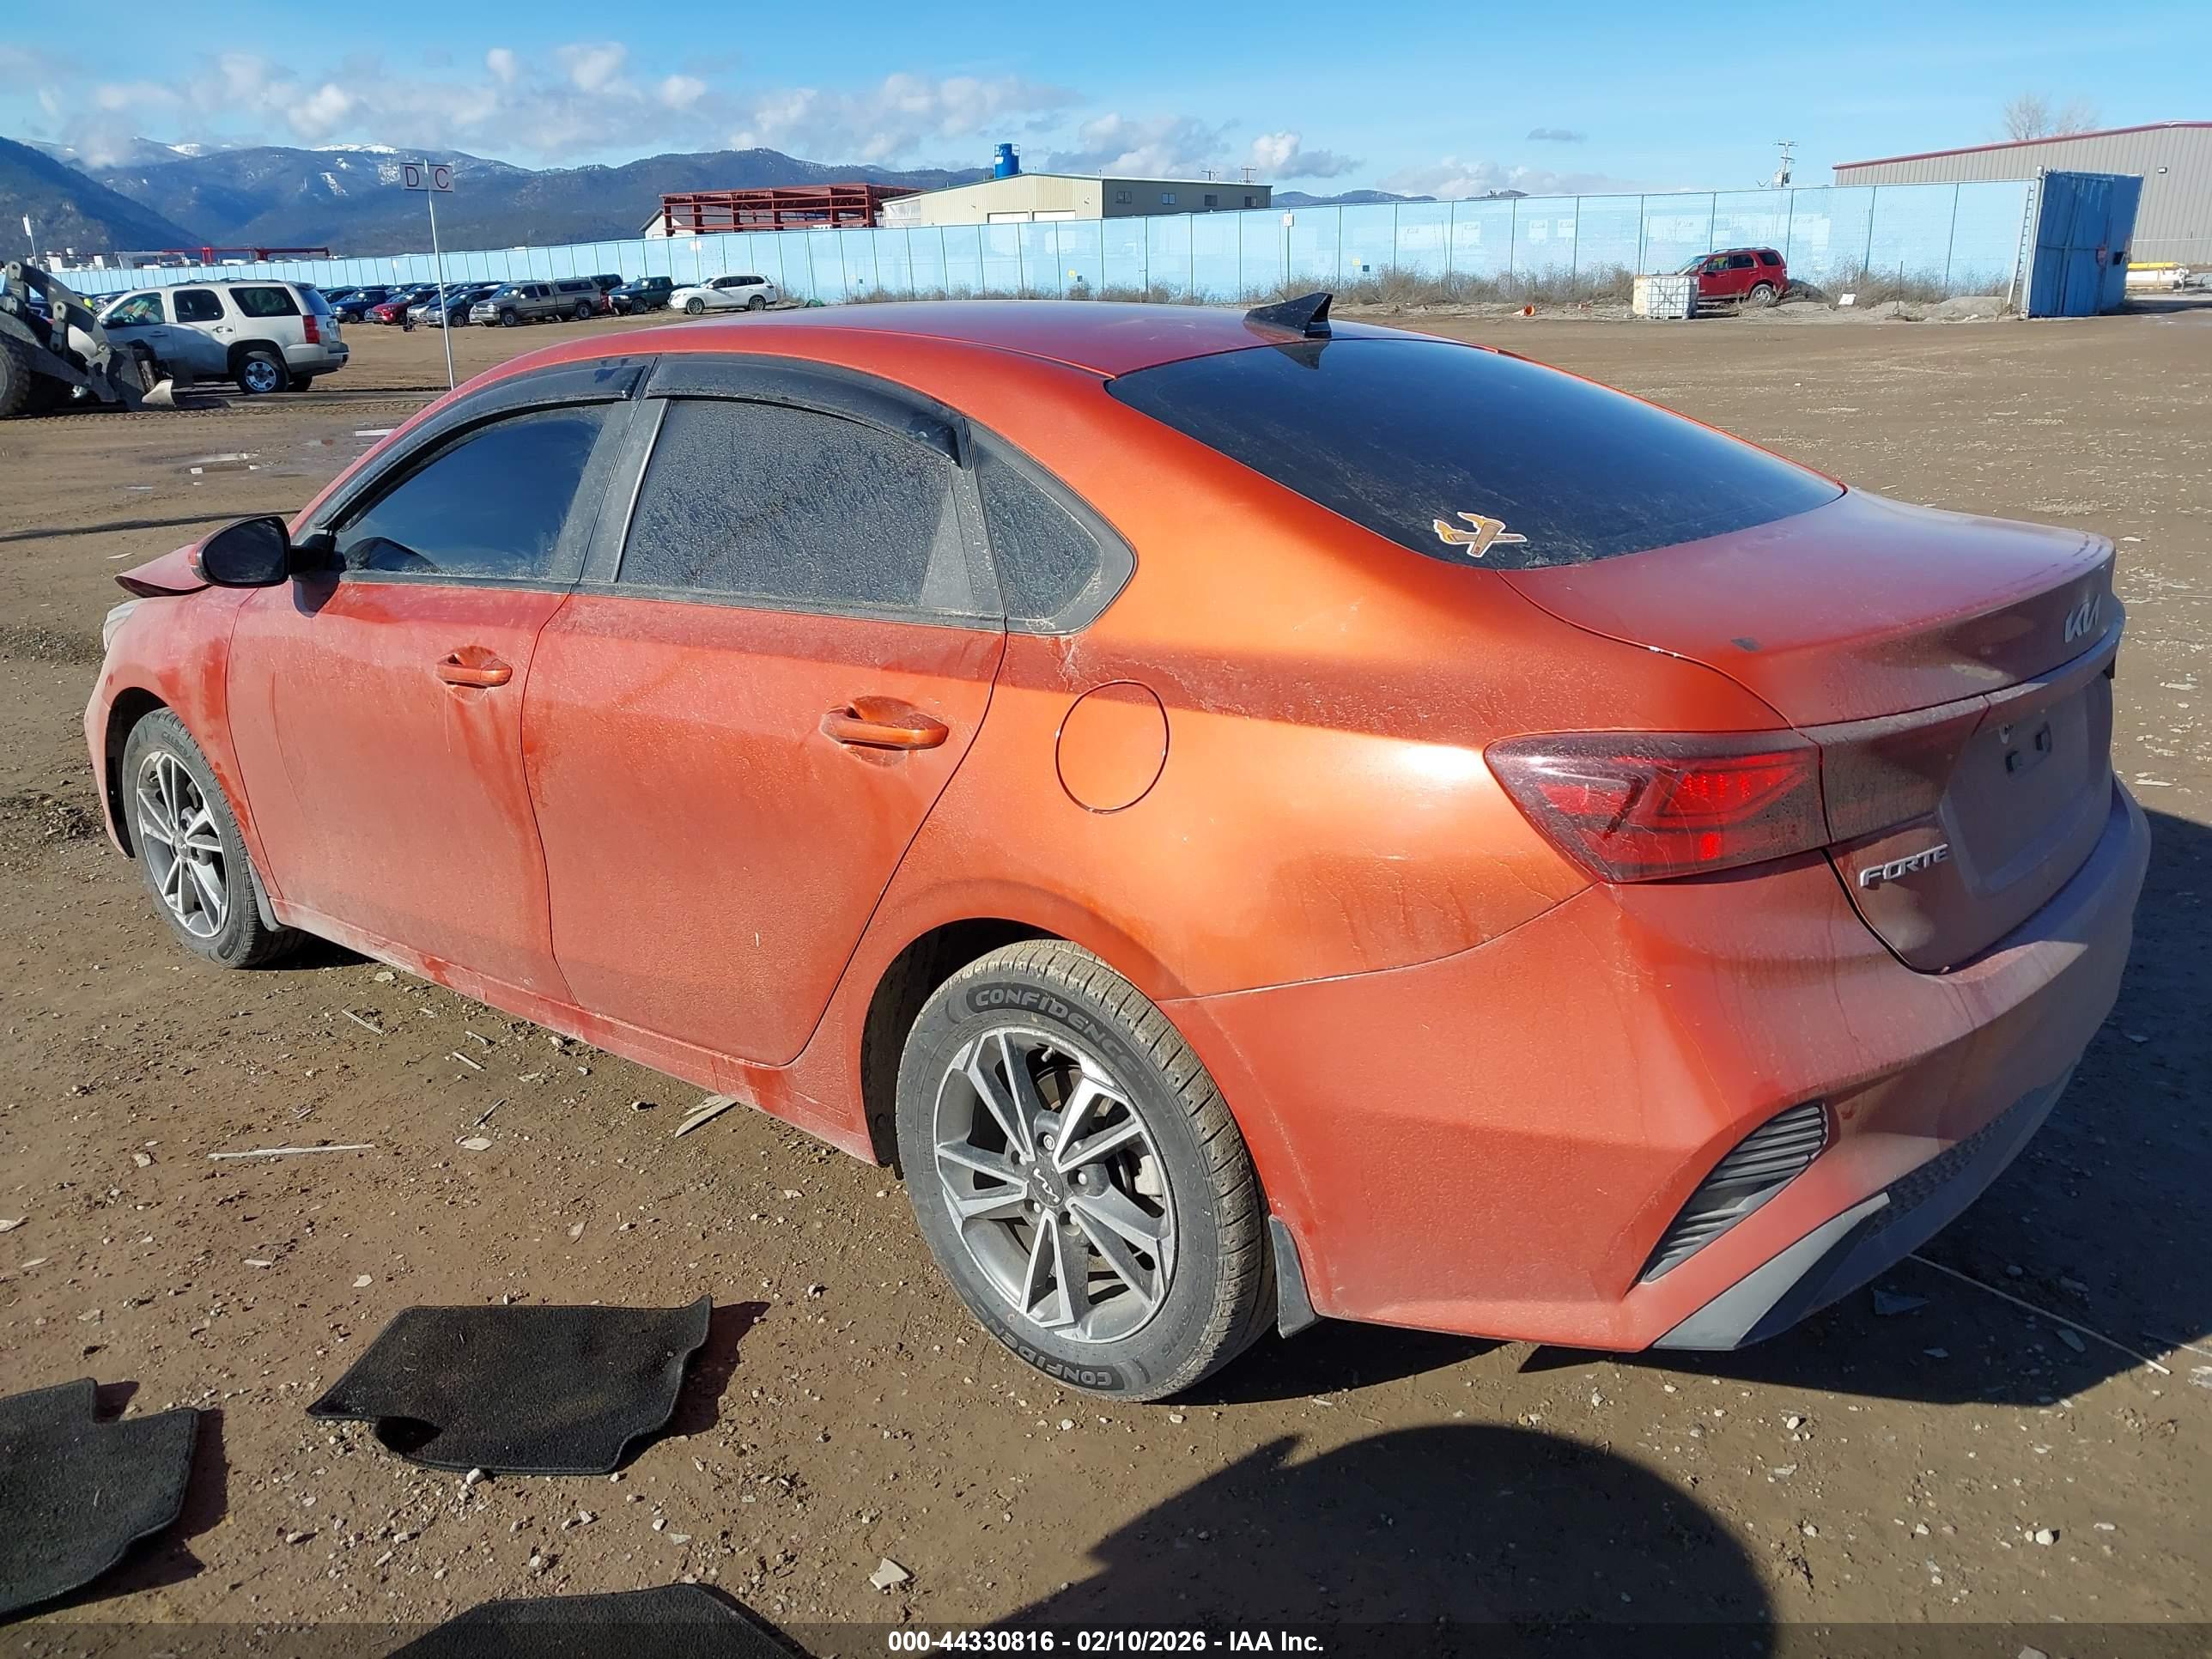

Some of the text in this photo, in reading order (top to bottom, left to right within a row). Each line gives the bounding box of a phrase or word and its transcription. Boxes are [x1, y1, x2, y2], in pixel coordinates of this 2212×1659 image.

[404, 166, 449, 189] D C
[1859, 843, 1948, 887] FORTE
[975, 988, 1139, 1073] CONFIDENCE
